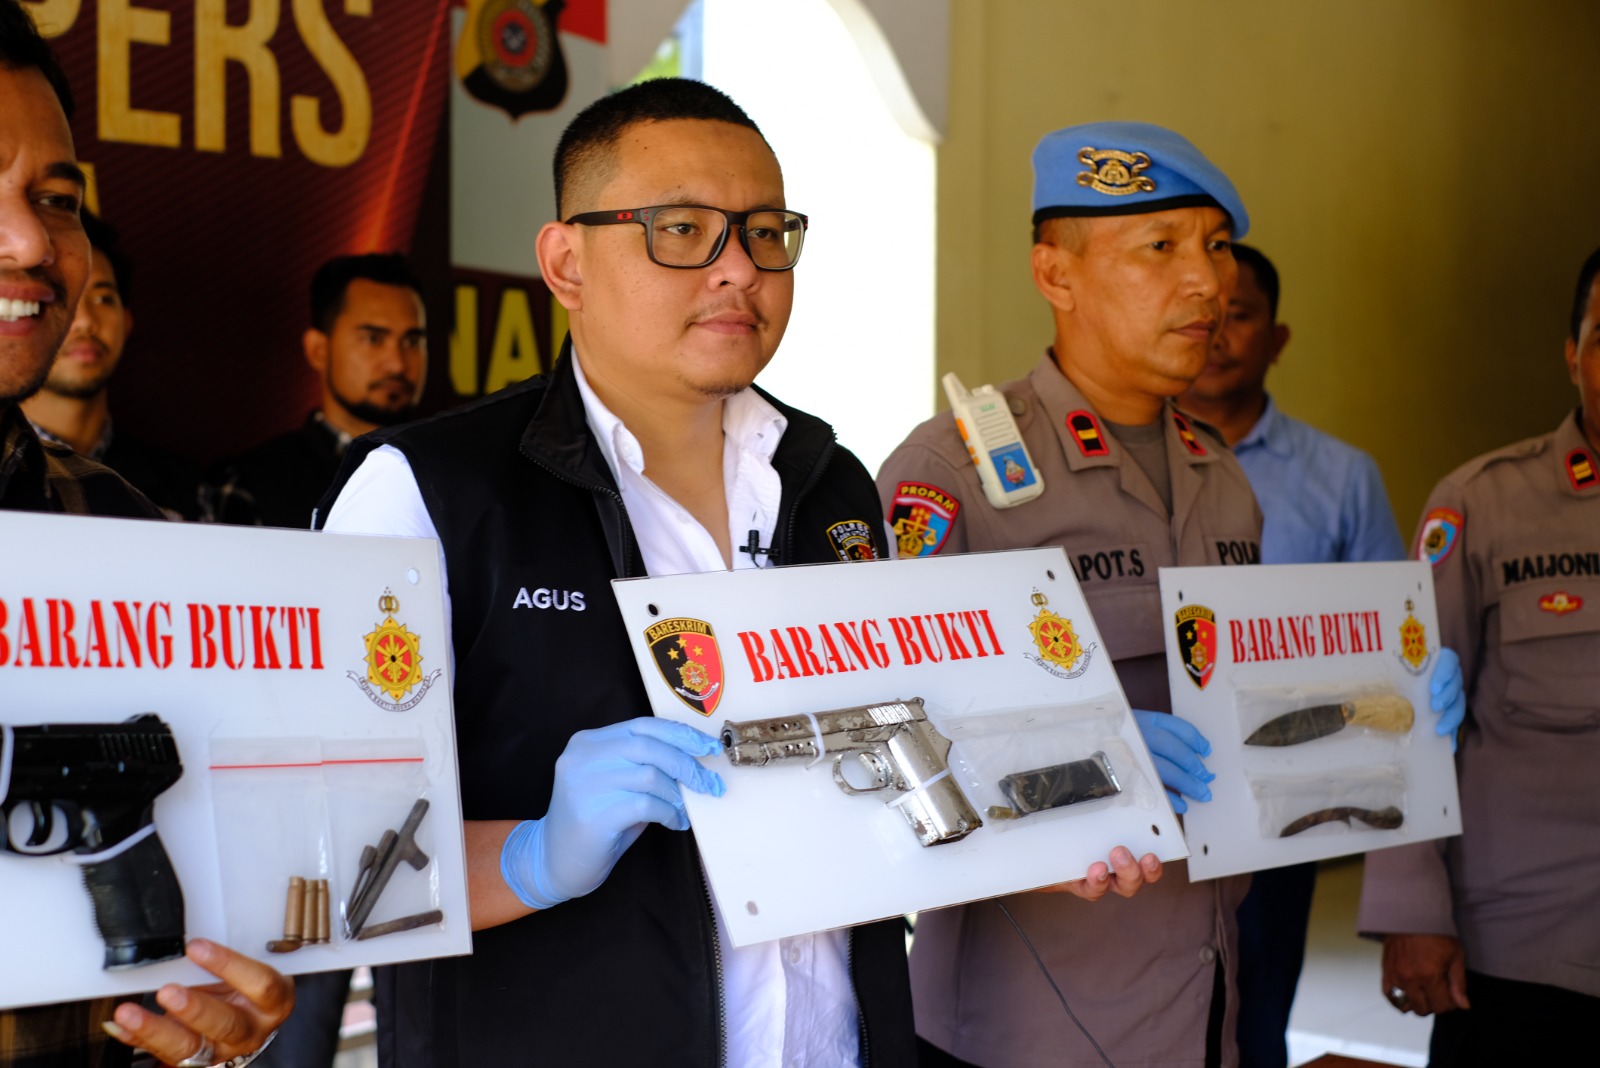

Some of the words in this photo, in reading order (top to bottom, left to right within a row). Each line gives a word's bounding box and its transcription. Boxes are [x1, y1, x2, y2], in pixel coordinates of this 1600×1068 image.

[901, 486, 954, 511] PROPAM
[512, 587, 586, 611] AGUS
[187, 603, 324, 670] BUKTI
[648, 620, 707, 640] BARESKRIM
[737, 618, 890, 682] BARANG
[888, 609, 1005, 665] BUKTI
[1229, 615, 1316, 663] BARANG
[1320, 610, 1383, 656] BUKTI
